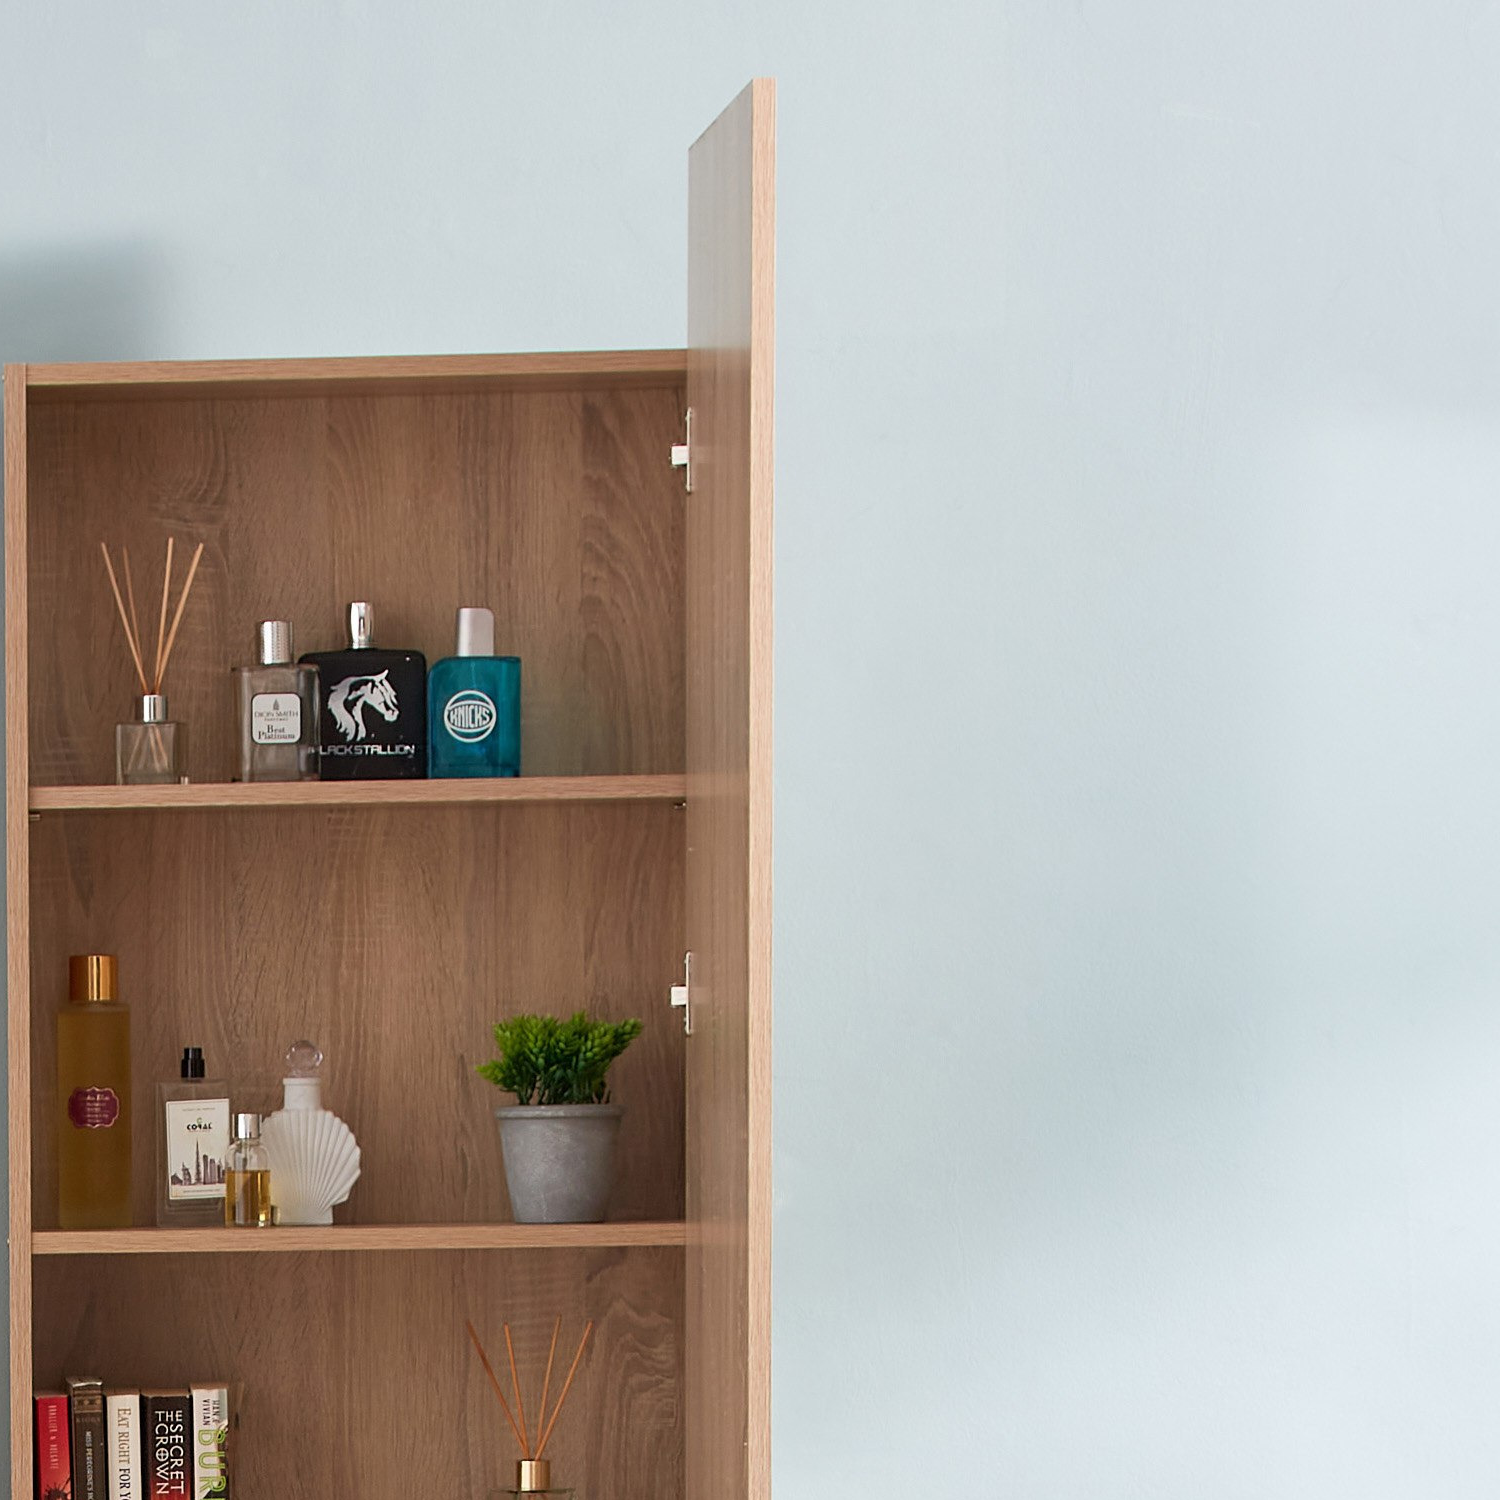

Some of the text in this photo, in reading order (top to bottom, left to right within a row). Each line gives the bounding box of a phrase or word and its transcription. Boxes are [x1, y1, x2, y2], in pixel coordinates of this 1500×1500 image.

[450, 704, 490, 728] KNICKS
[155, 1410, 183, 1422] THE
[202, 1398, 211, 1426] VIVIAN
[118, 1432, 130, 1464] RIGHT
[155, 1423, 170, 1495] CROWN
[169, 1424, 185, 1495] SECRET
[119, 1468, 131, 1489] FOR
